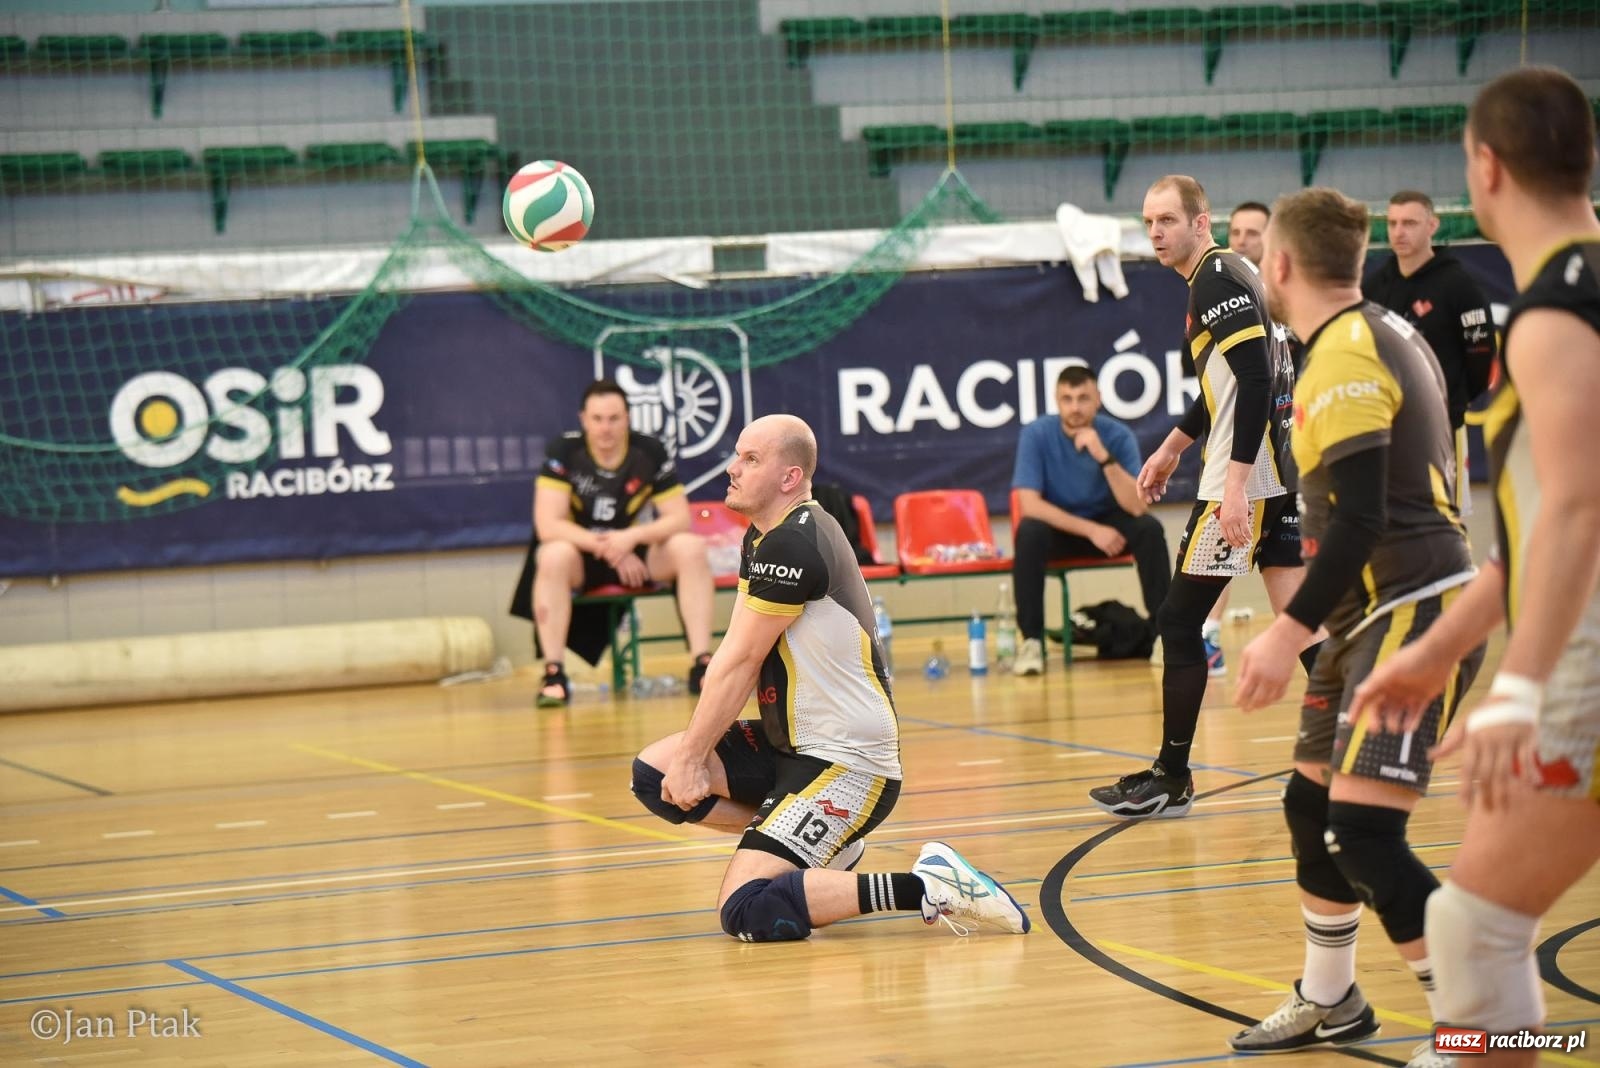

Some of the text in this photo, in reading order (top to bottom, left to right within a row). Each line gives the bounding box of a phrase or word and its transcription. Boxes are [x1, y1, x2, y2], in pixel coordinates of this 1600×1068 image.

[109, 364, 392, 468] OSiR
[227, 459, 394, 500] RACIBÓRZ
[592, 496, 617, 521] 15
[1211, 537, 1232, 562] 3
[791, 810, 829, 847] 13
